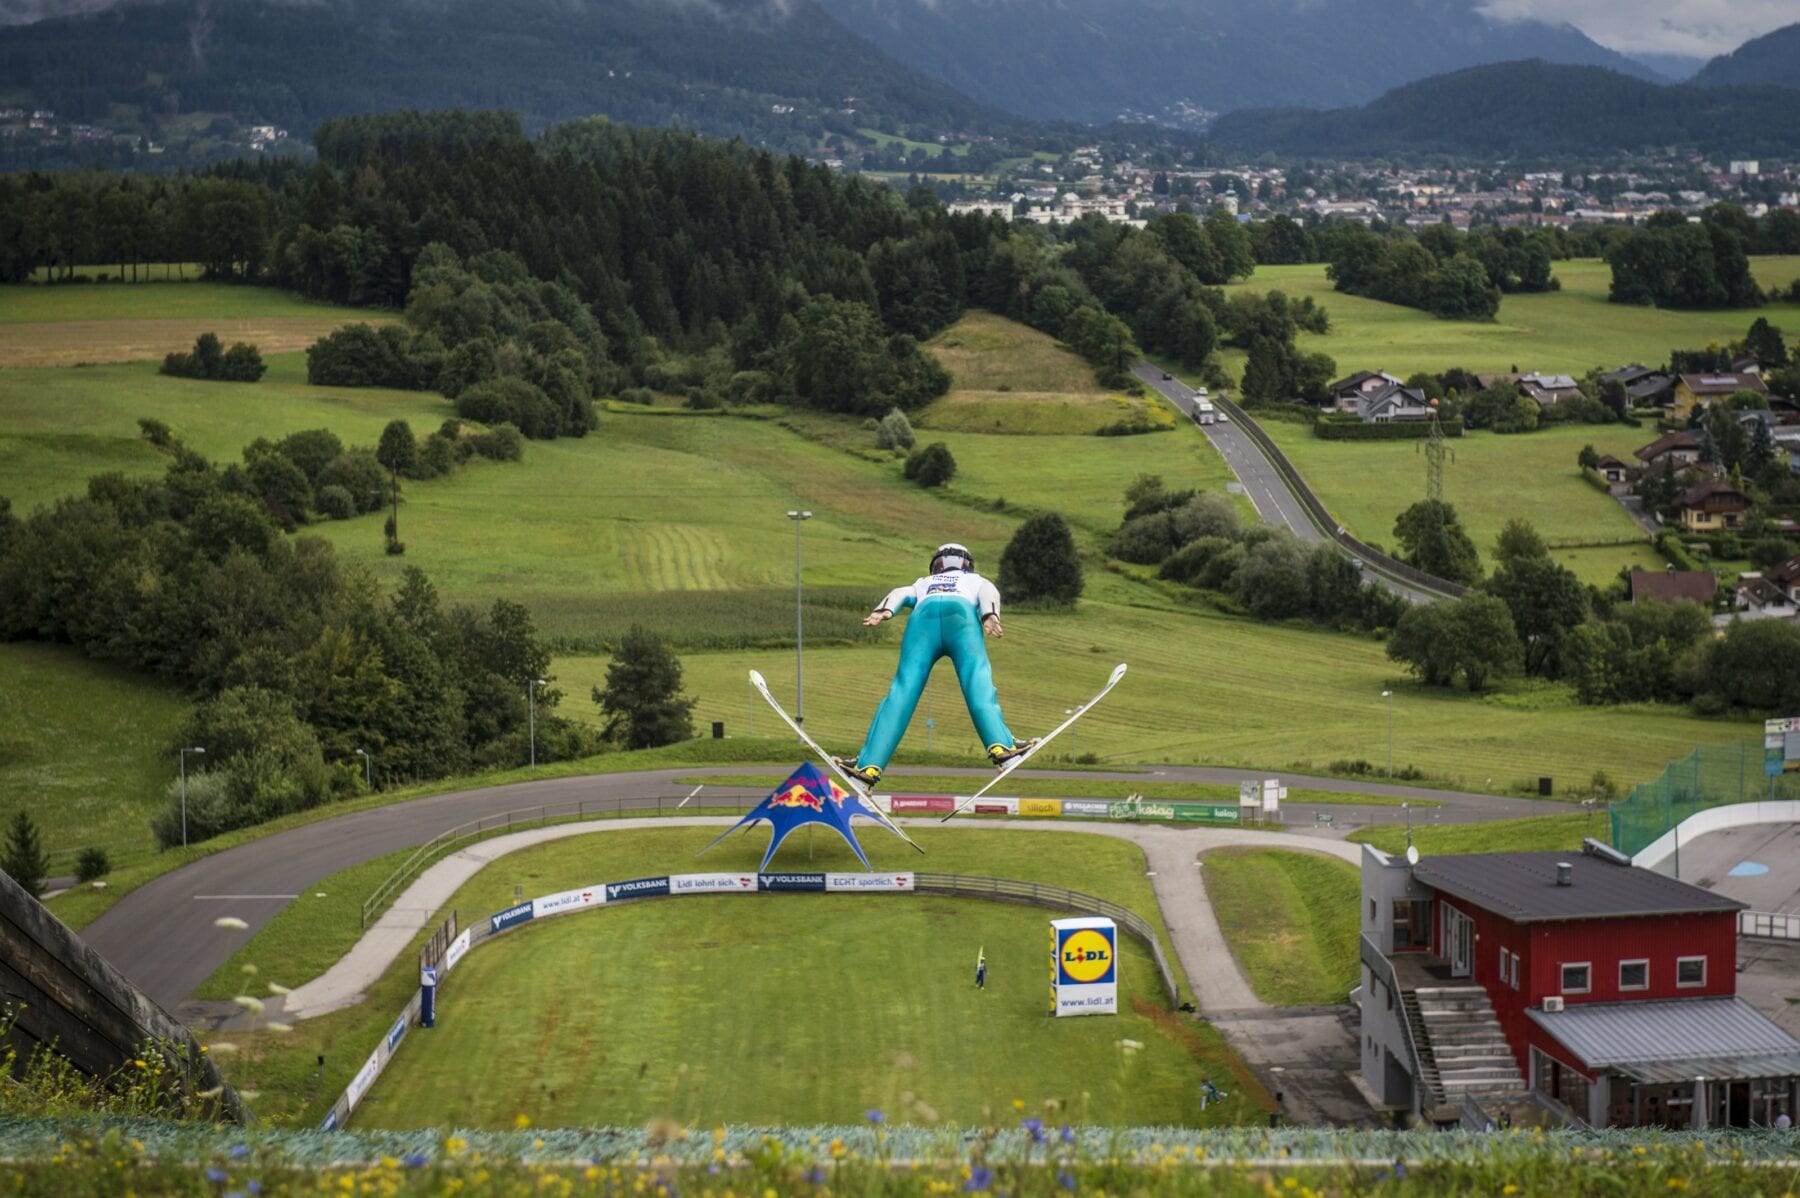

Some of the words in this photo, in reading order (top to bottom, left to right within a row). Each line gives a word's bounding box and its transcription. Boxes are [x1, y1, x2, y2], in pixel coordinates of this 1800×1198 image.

[622, 880, 668, 891] VOLKSBANK
[677, 879, 693, 889] Lidl
[695, 880, 715, 888] lohnt
[833, 878, 856, 886] ECHT
[542, 894, 580, 910] www.lidl.at
[502, 903, 532, 921] VOLKSBANK
[1060, 997, 1114, 1007] www.lidl.at
